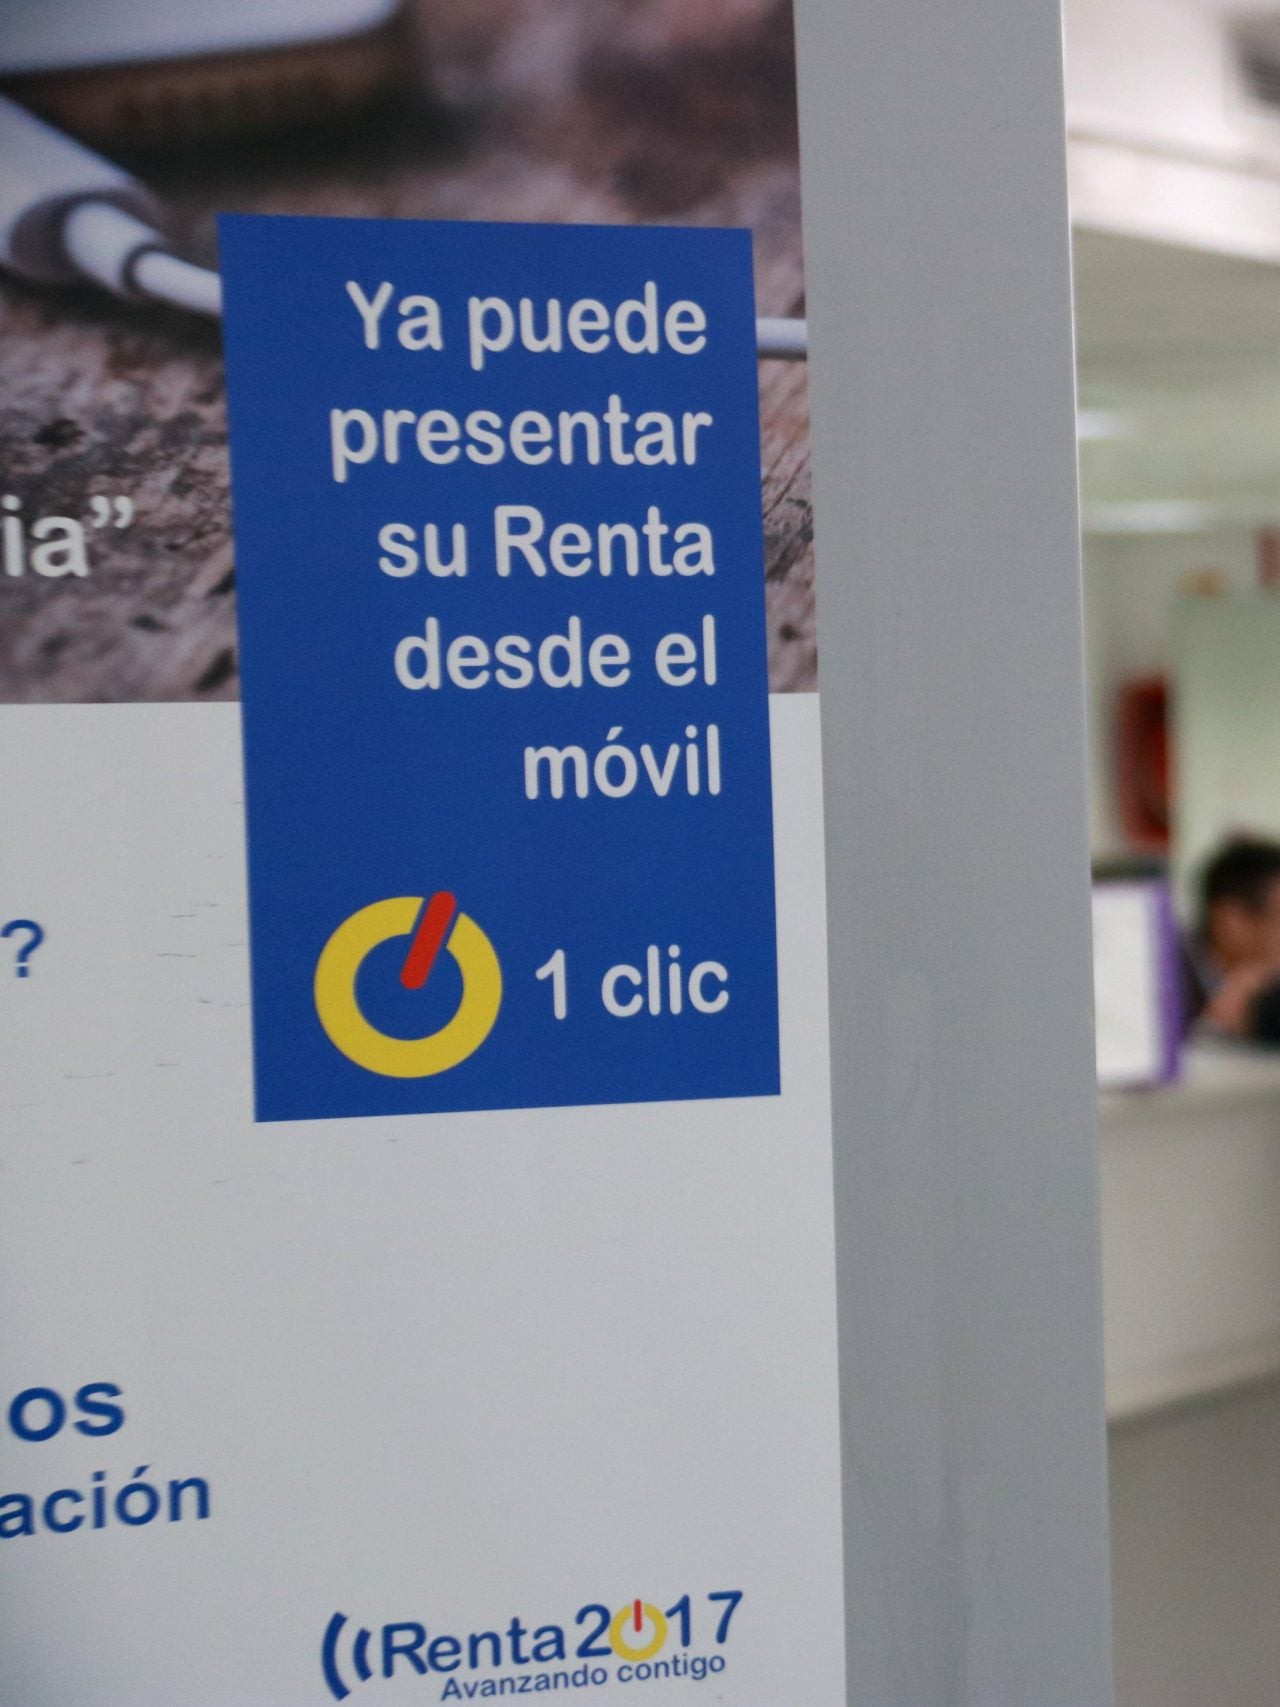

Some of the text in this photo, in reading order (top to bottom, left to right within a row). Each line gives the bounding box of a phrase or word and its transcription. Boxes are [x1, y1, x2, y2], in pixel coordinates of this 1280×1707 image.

[347, 281, 708, 372] Ya puede
[331, 395, 714, 484] presentar
[379, 506, 716, 579] su Renta
[395, 615, 718, 691] desde el
[525, 725, 723, 801] móvil
[0, 919, 45, 979] ?
[536, 945, 730, 1021] 1 clic
[8, 1382, 126, 1443] os
[0, 1464, 211, 1540] ación
[439, 1651, 726, 1701] Avanzando contigo
